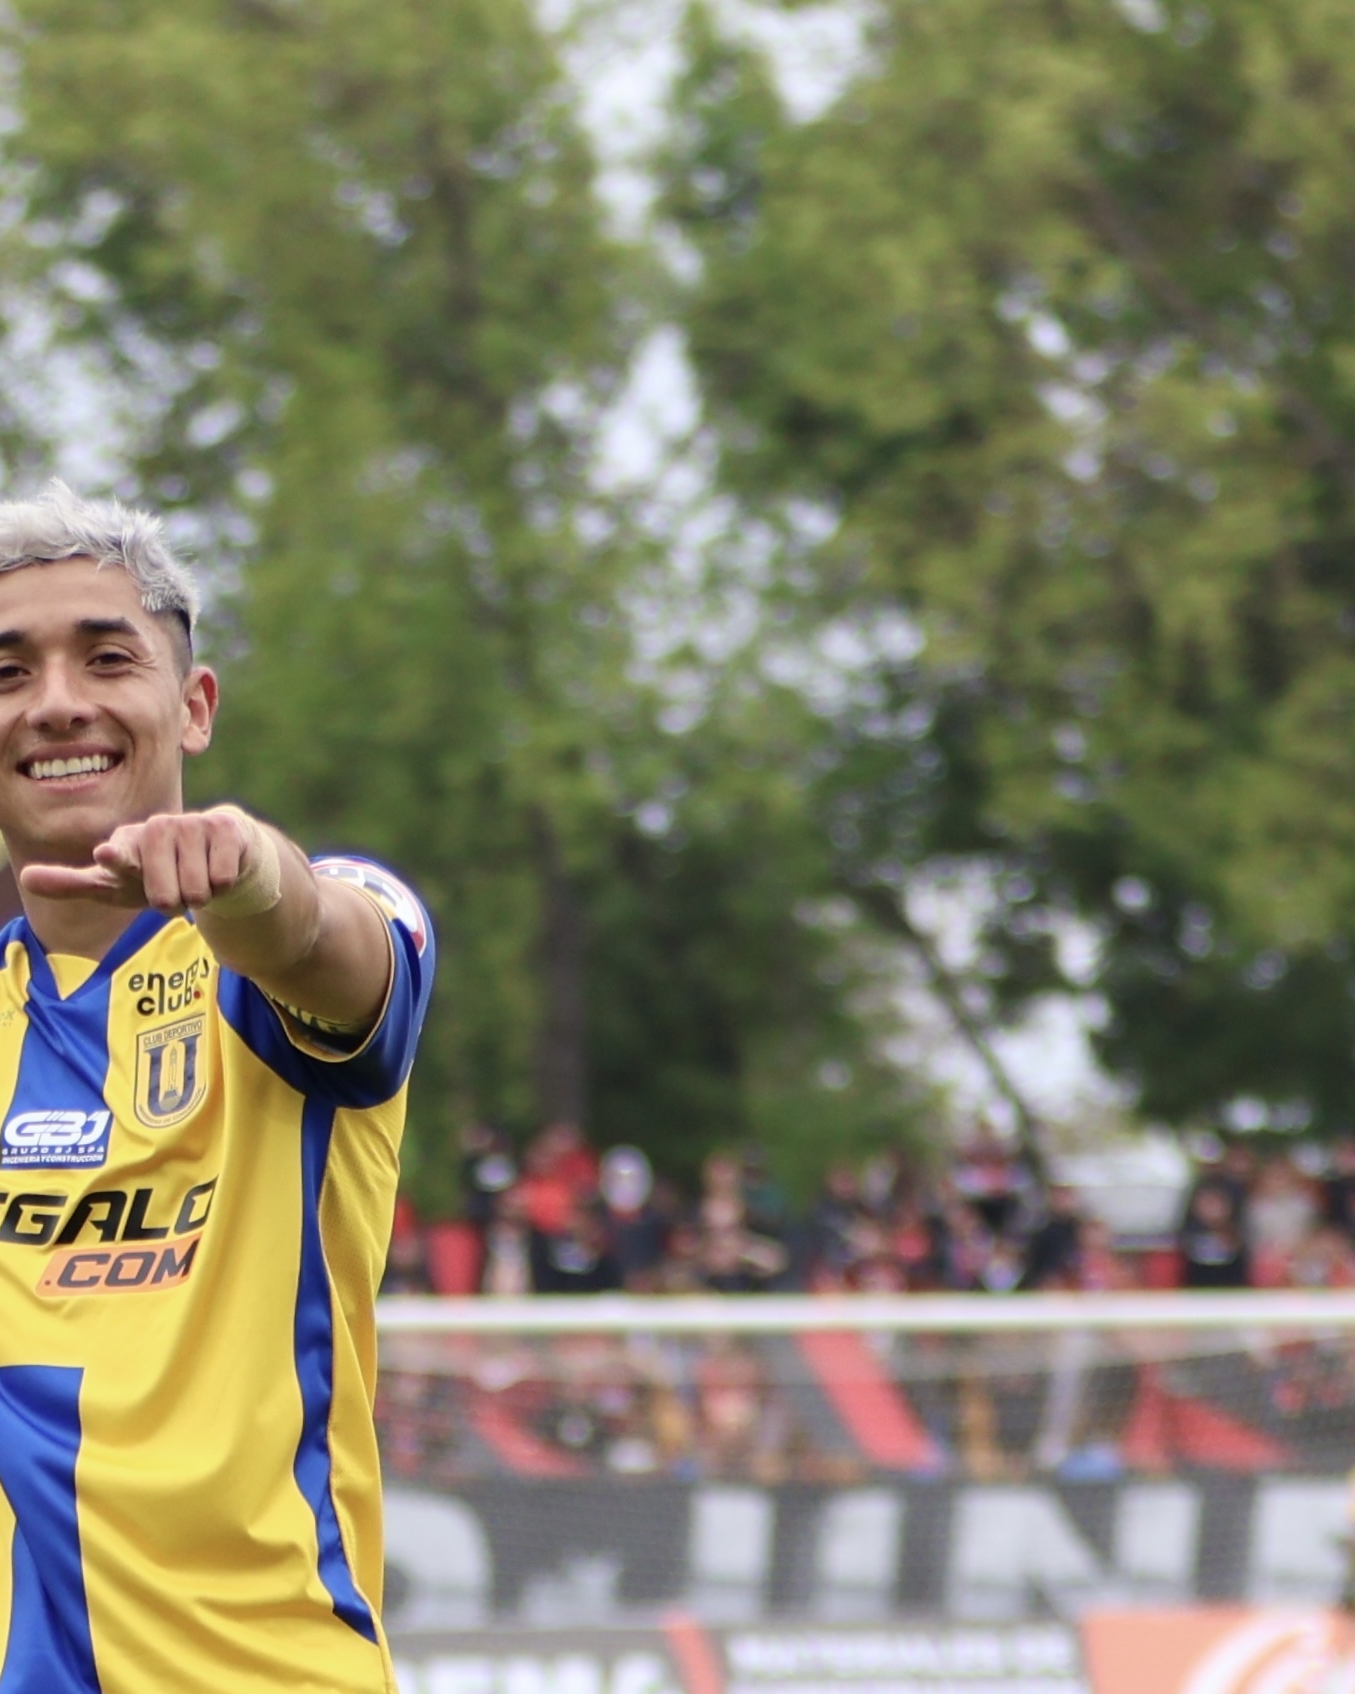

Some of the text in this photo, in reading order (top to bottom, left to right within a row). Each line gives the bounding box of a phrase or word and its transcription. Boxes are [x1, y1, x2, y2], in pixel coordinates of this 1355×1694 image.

[143, 1021, 203, 1046] CLUB DEPORTIVO
[1, 1147, 49, 1156] GRUPO
